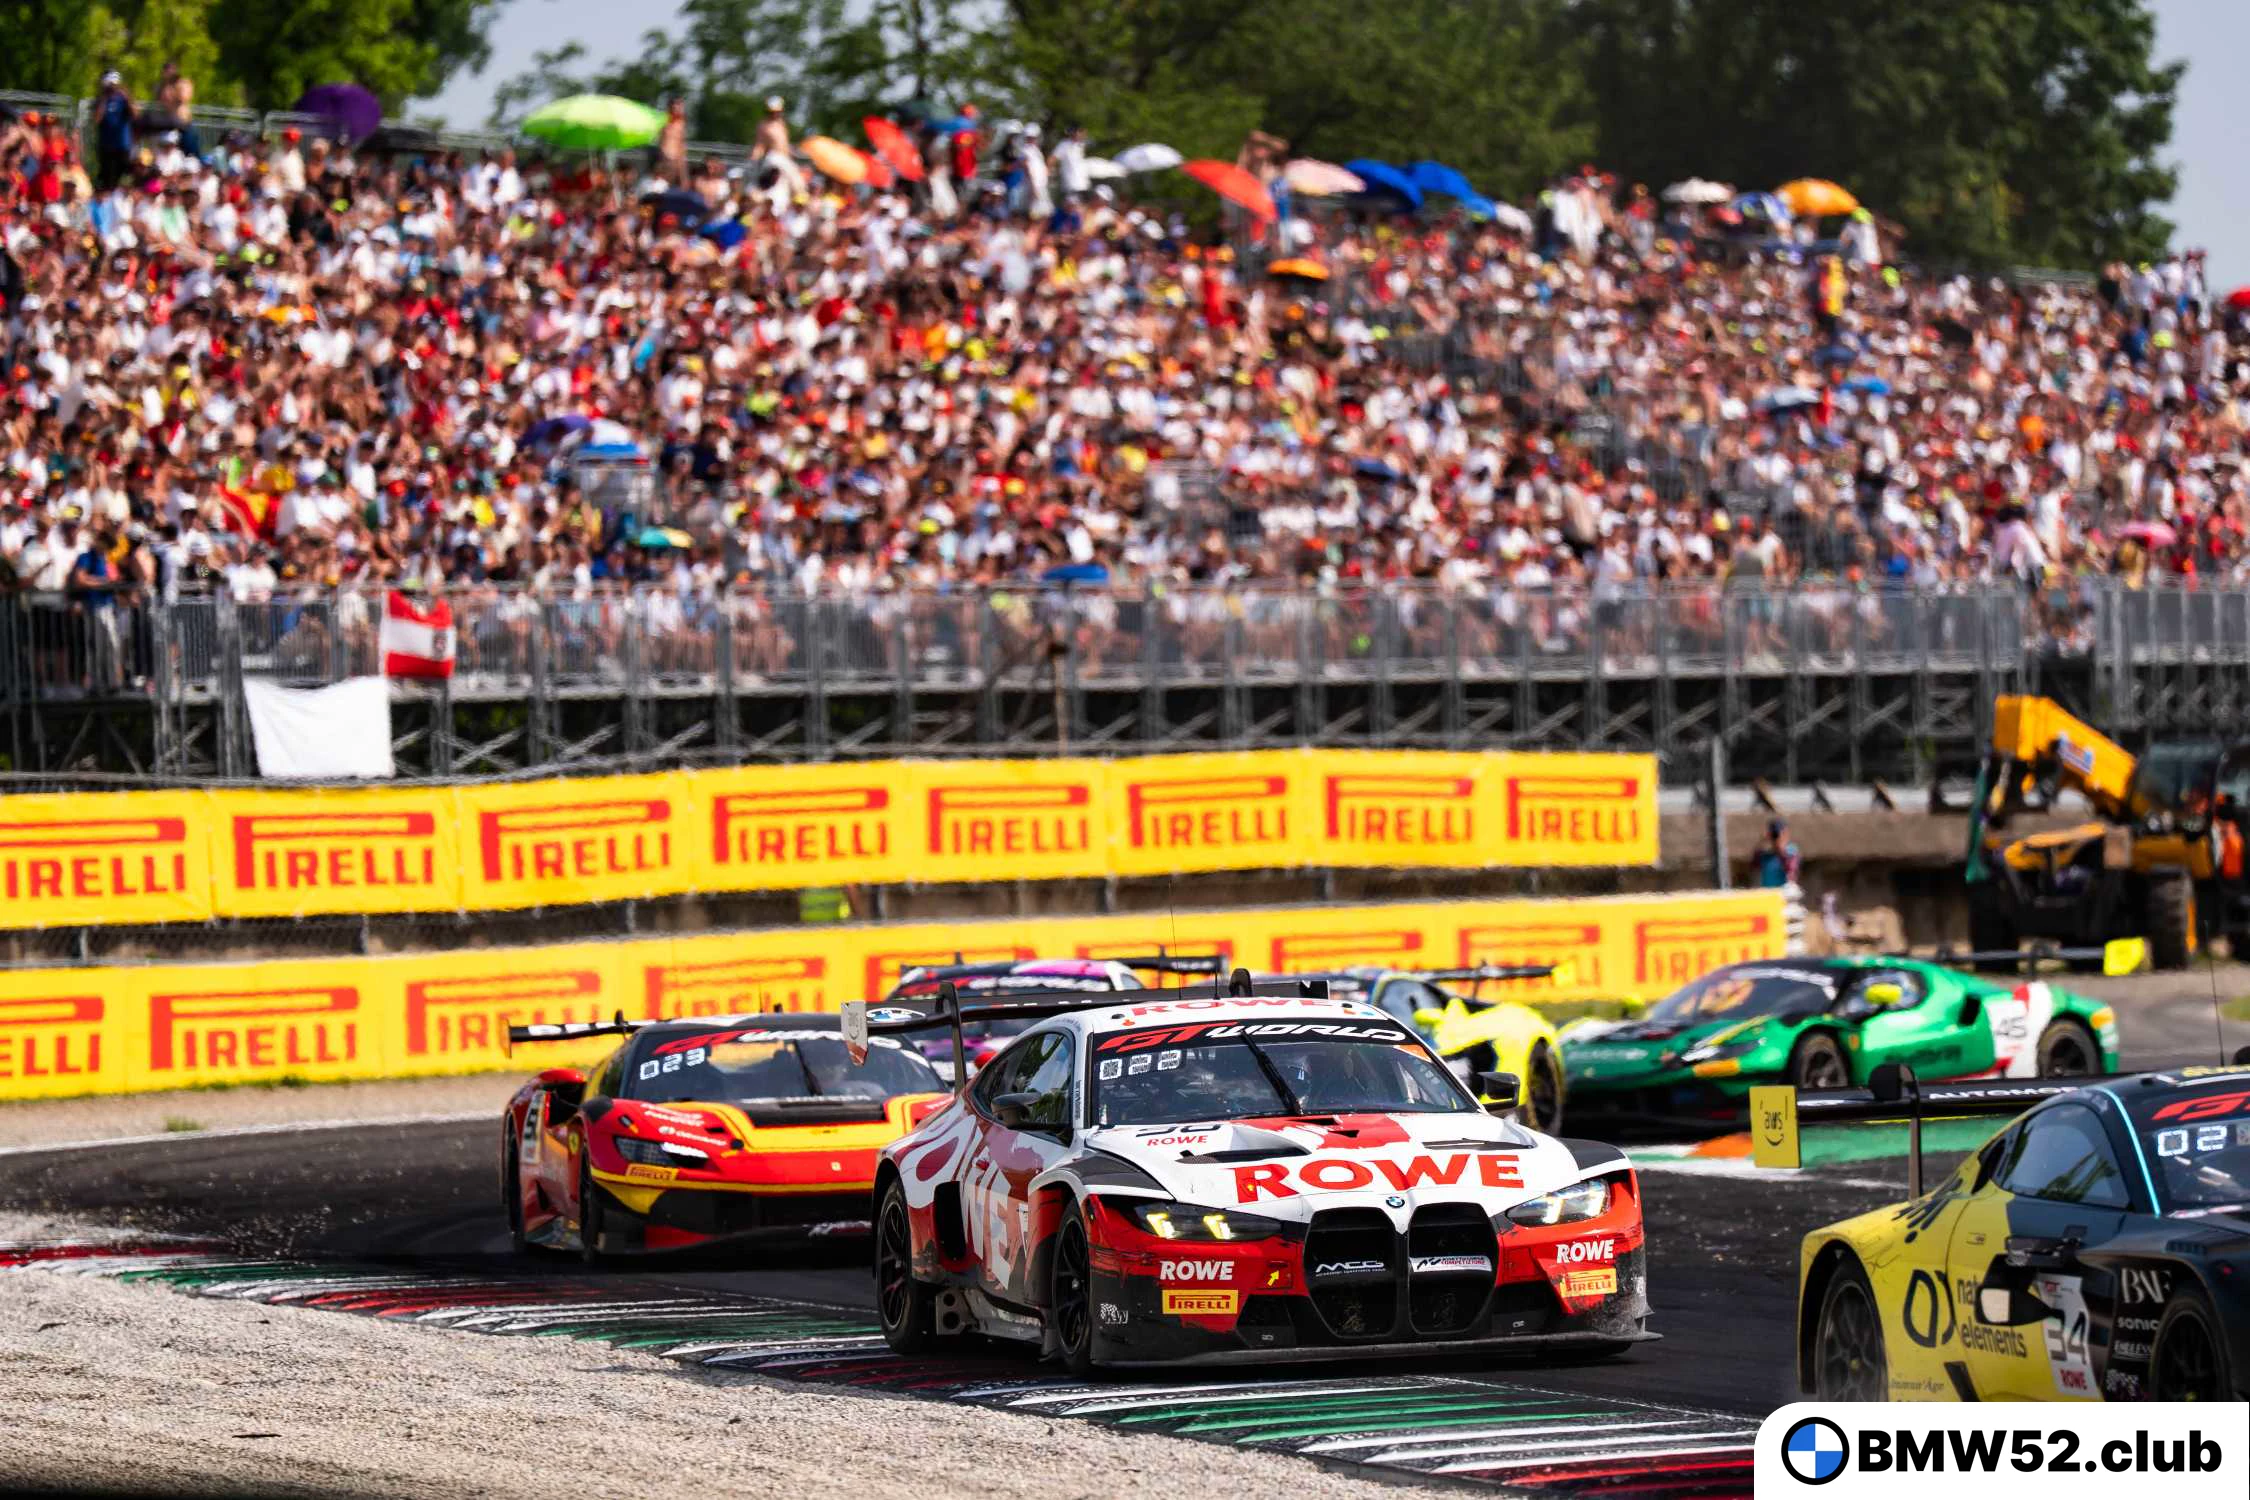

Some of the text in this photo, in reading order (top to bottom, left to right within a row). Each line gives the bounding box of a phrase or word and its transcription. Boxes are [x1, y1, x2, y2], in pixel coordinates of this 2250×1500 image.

[713, 787, 889, 863] PIRELLI
[928, 785, 1089, 854] PIRELLI
[1127, 776, 1287, 847] PIRELLI
[1326, 774, 1474, 843] PIRELLI
[1507, 777, 1639, 843] PIRELLI
[233, 812, 435, 889] PIRELLI
[480, 800, 670, 881] PIRELLI
[149, 987, 360, 1070] PIRELLI
[1147, 1134, 1208, 1146] ROWE
[1764, 1111, 1783, 1131] aws
[1229, 1154, 1525, 1204] ROWE
[1159, 1260, 1234, 1281] ROWE
[1556, 1239, 1615, 1264] ROWE
[1168, 1294, 1231, 1310] PIRELLI
[1563, 1273, 1611, 1292] PIRELLI
[1961, 1315, 2028, 1359] elements
[2047, 1310, 2089, 1366] 34
[2117, 1316, 2160, 1331] sonic
[2060, 1369, 2088, 1391] ROWE
